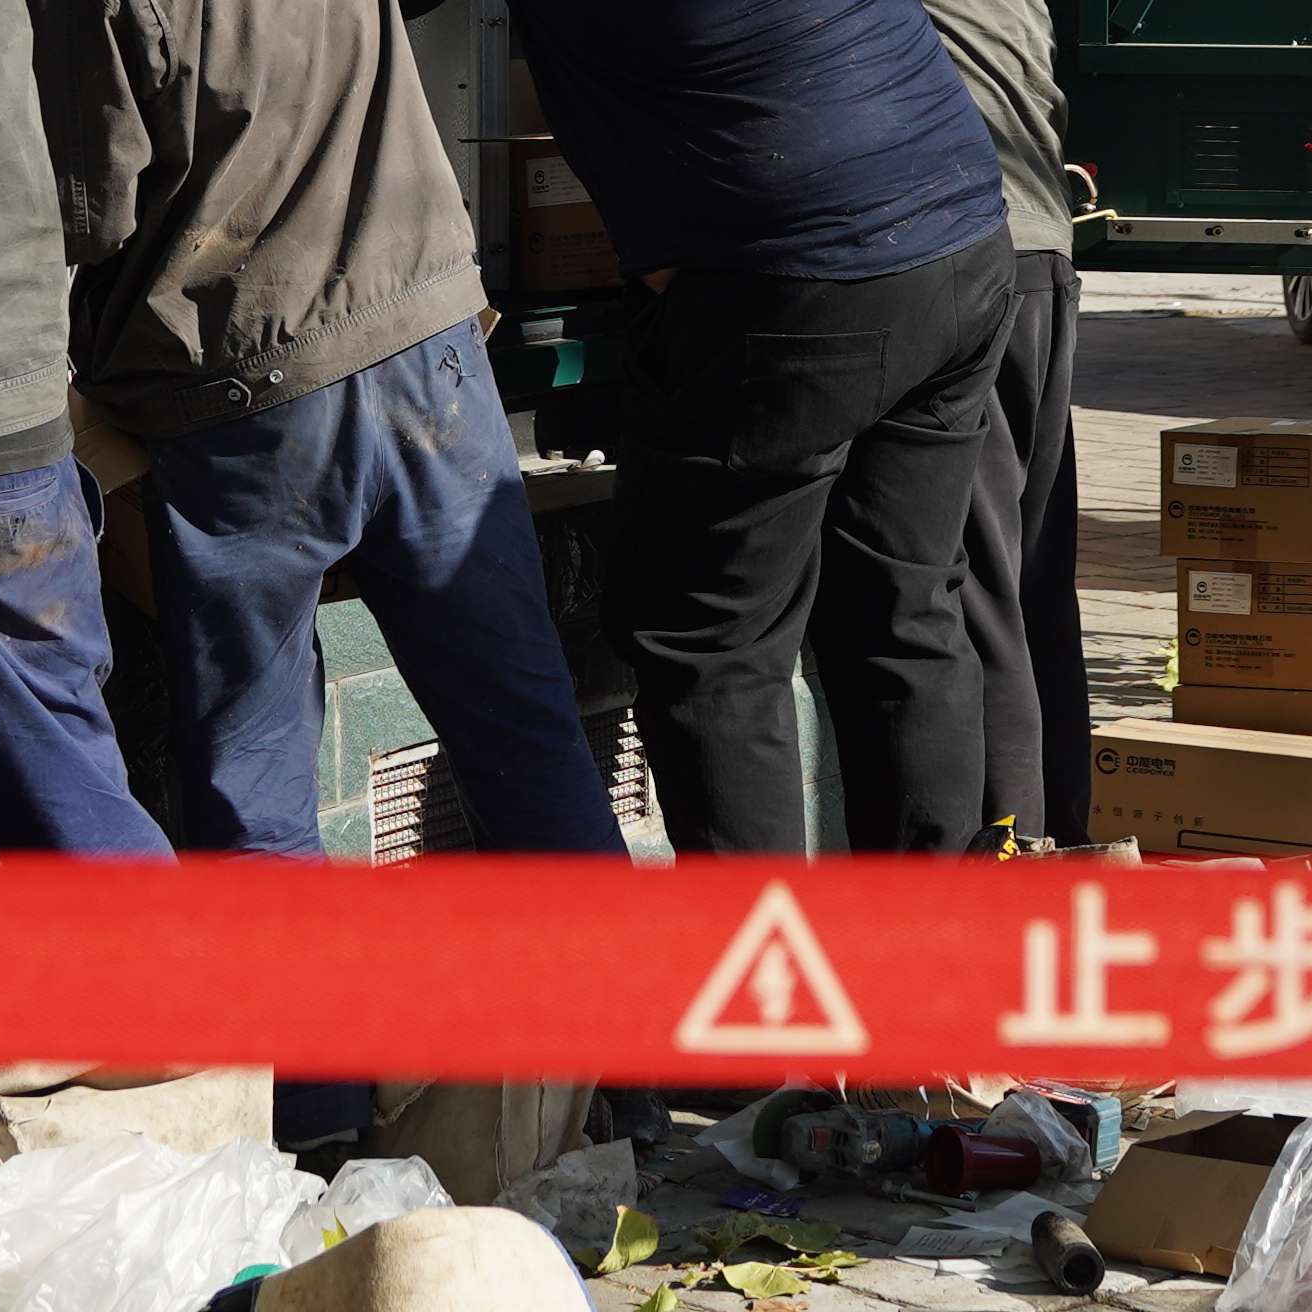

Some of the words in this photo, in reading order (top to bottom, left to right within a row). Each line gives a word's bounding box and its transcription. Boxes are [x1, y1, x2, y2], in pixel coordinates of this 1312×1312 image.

[1126, 755, 1176, 771] 中能电气
[1126, 766, 1175, 777] CEEPOWER
[1092, 803, 1205, 827] 永恒源于创新
